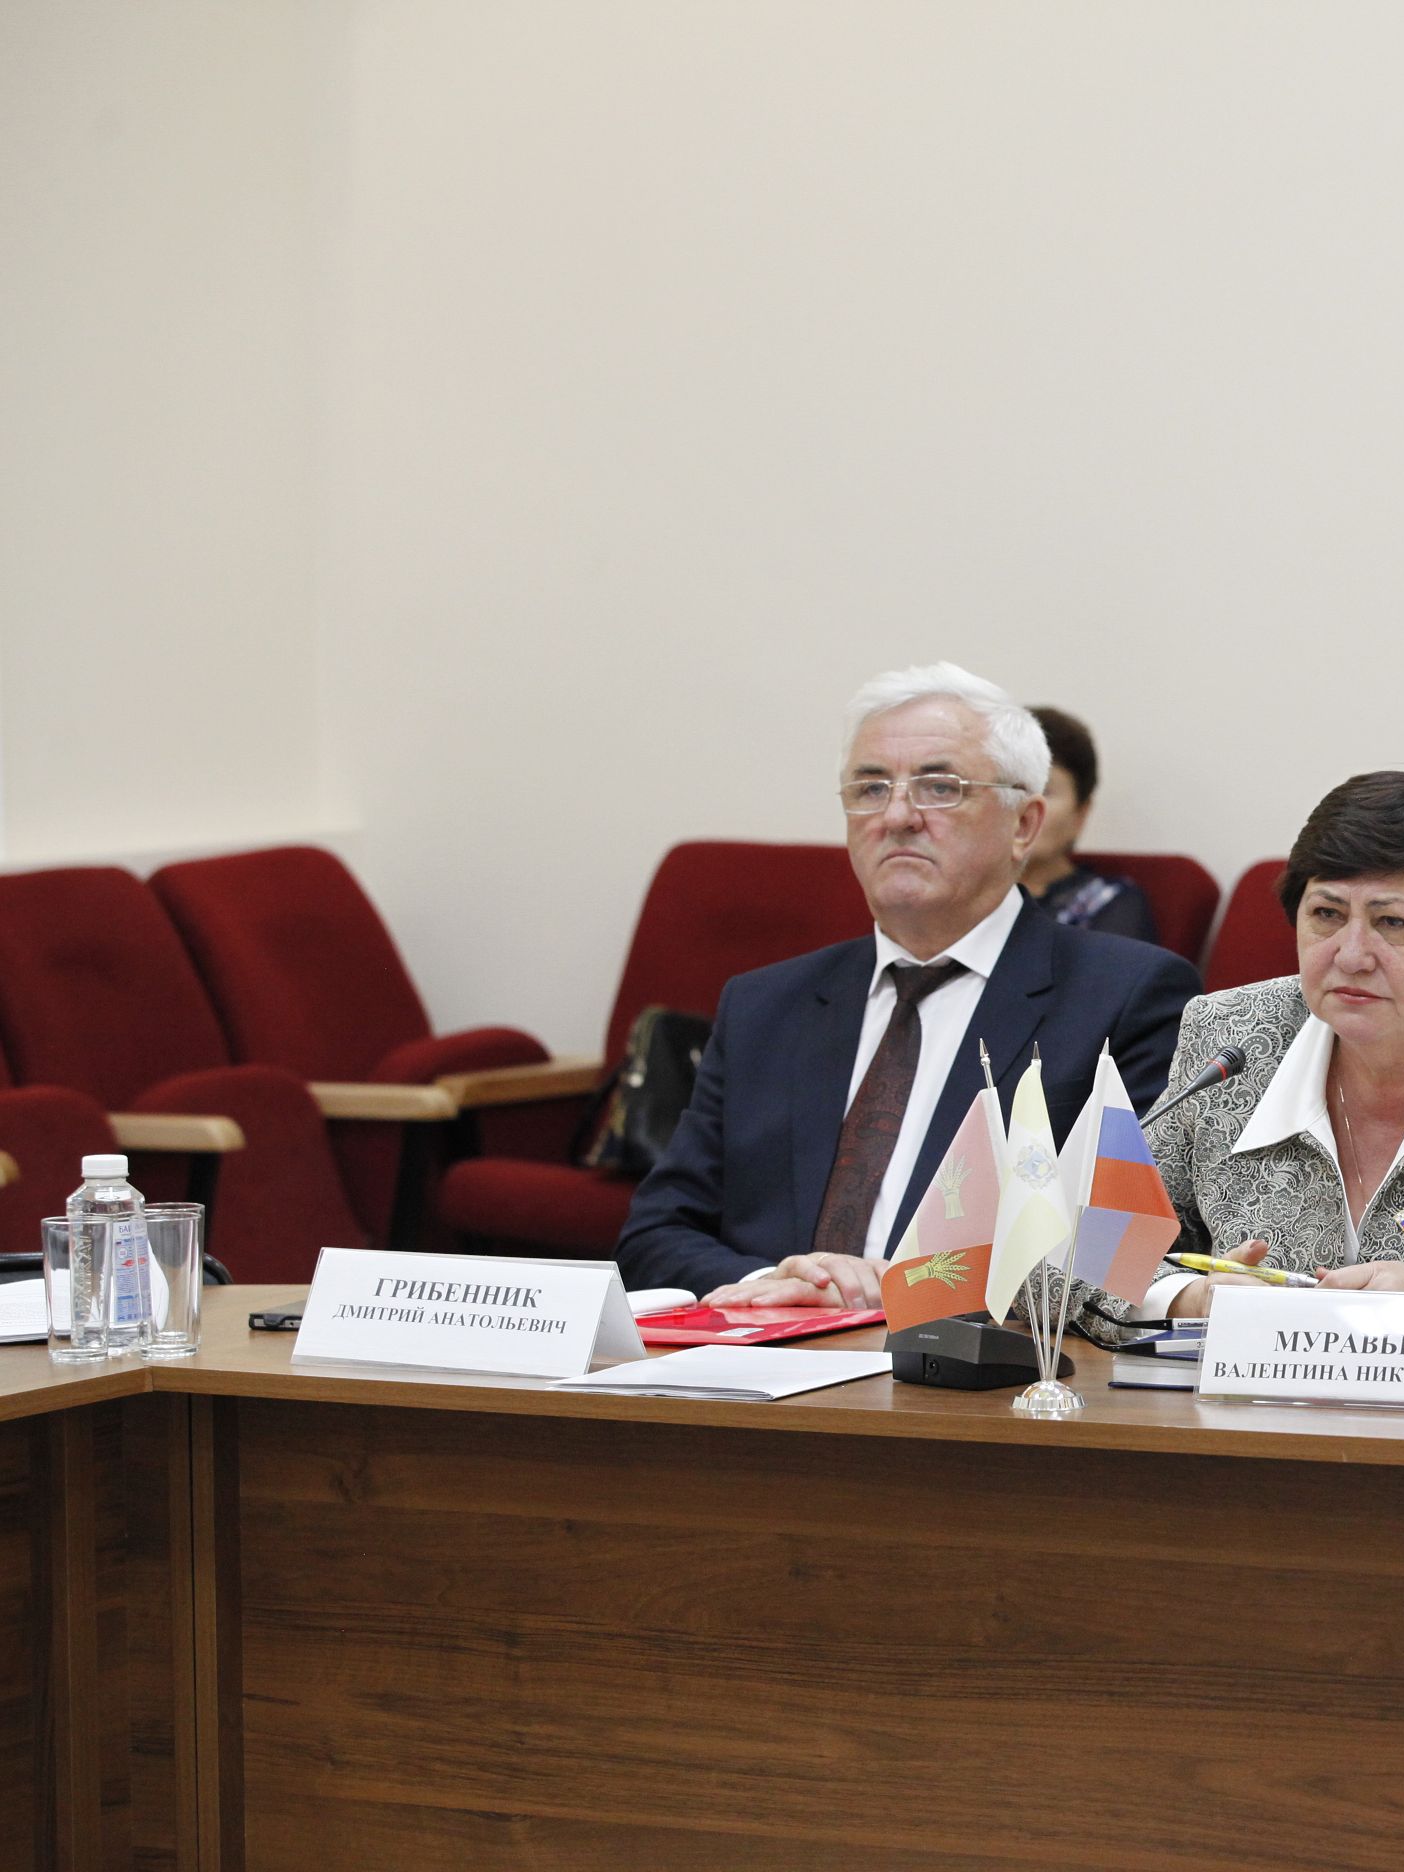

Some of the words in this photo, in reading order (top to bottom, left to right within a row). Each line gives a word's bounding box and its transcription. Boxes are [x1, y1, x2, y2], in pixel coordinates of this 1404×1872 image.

[373, 1277, 542, 1308] ГРИБЕННИК
[333, 1303, 425, 1323] ДМИТРИЙ
[428, 1311, 568, 1334] АНАТОЛЬЕВИЧ
[1213, 1361, 1349, 1382] ВАЛЕНТИНА
